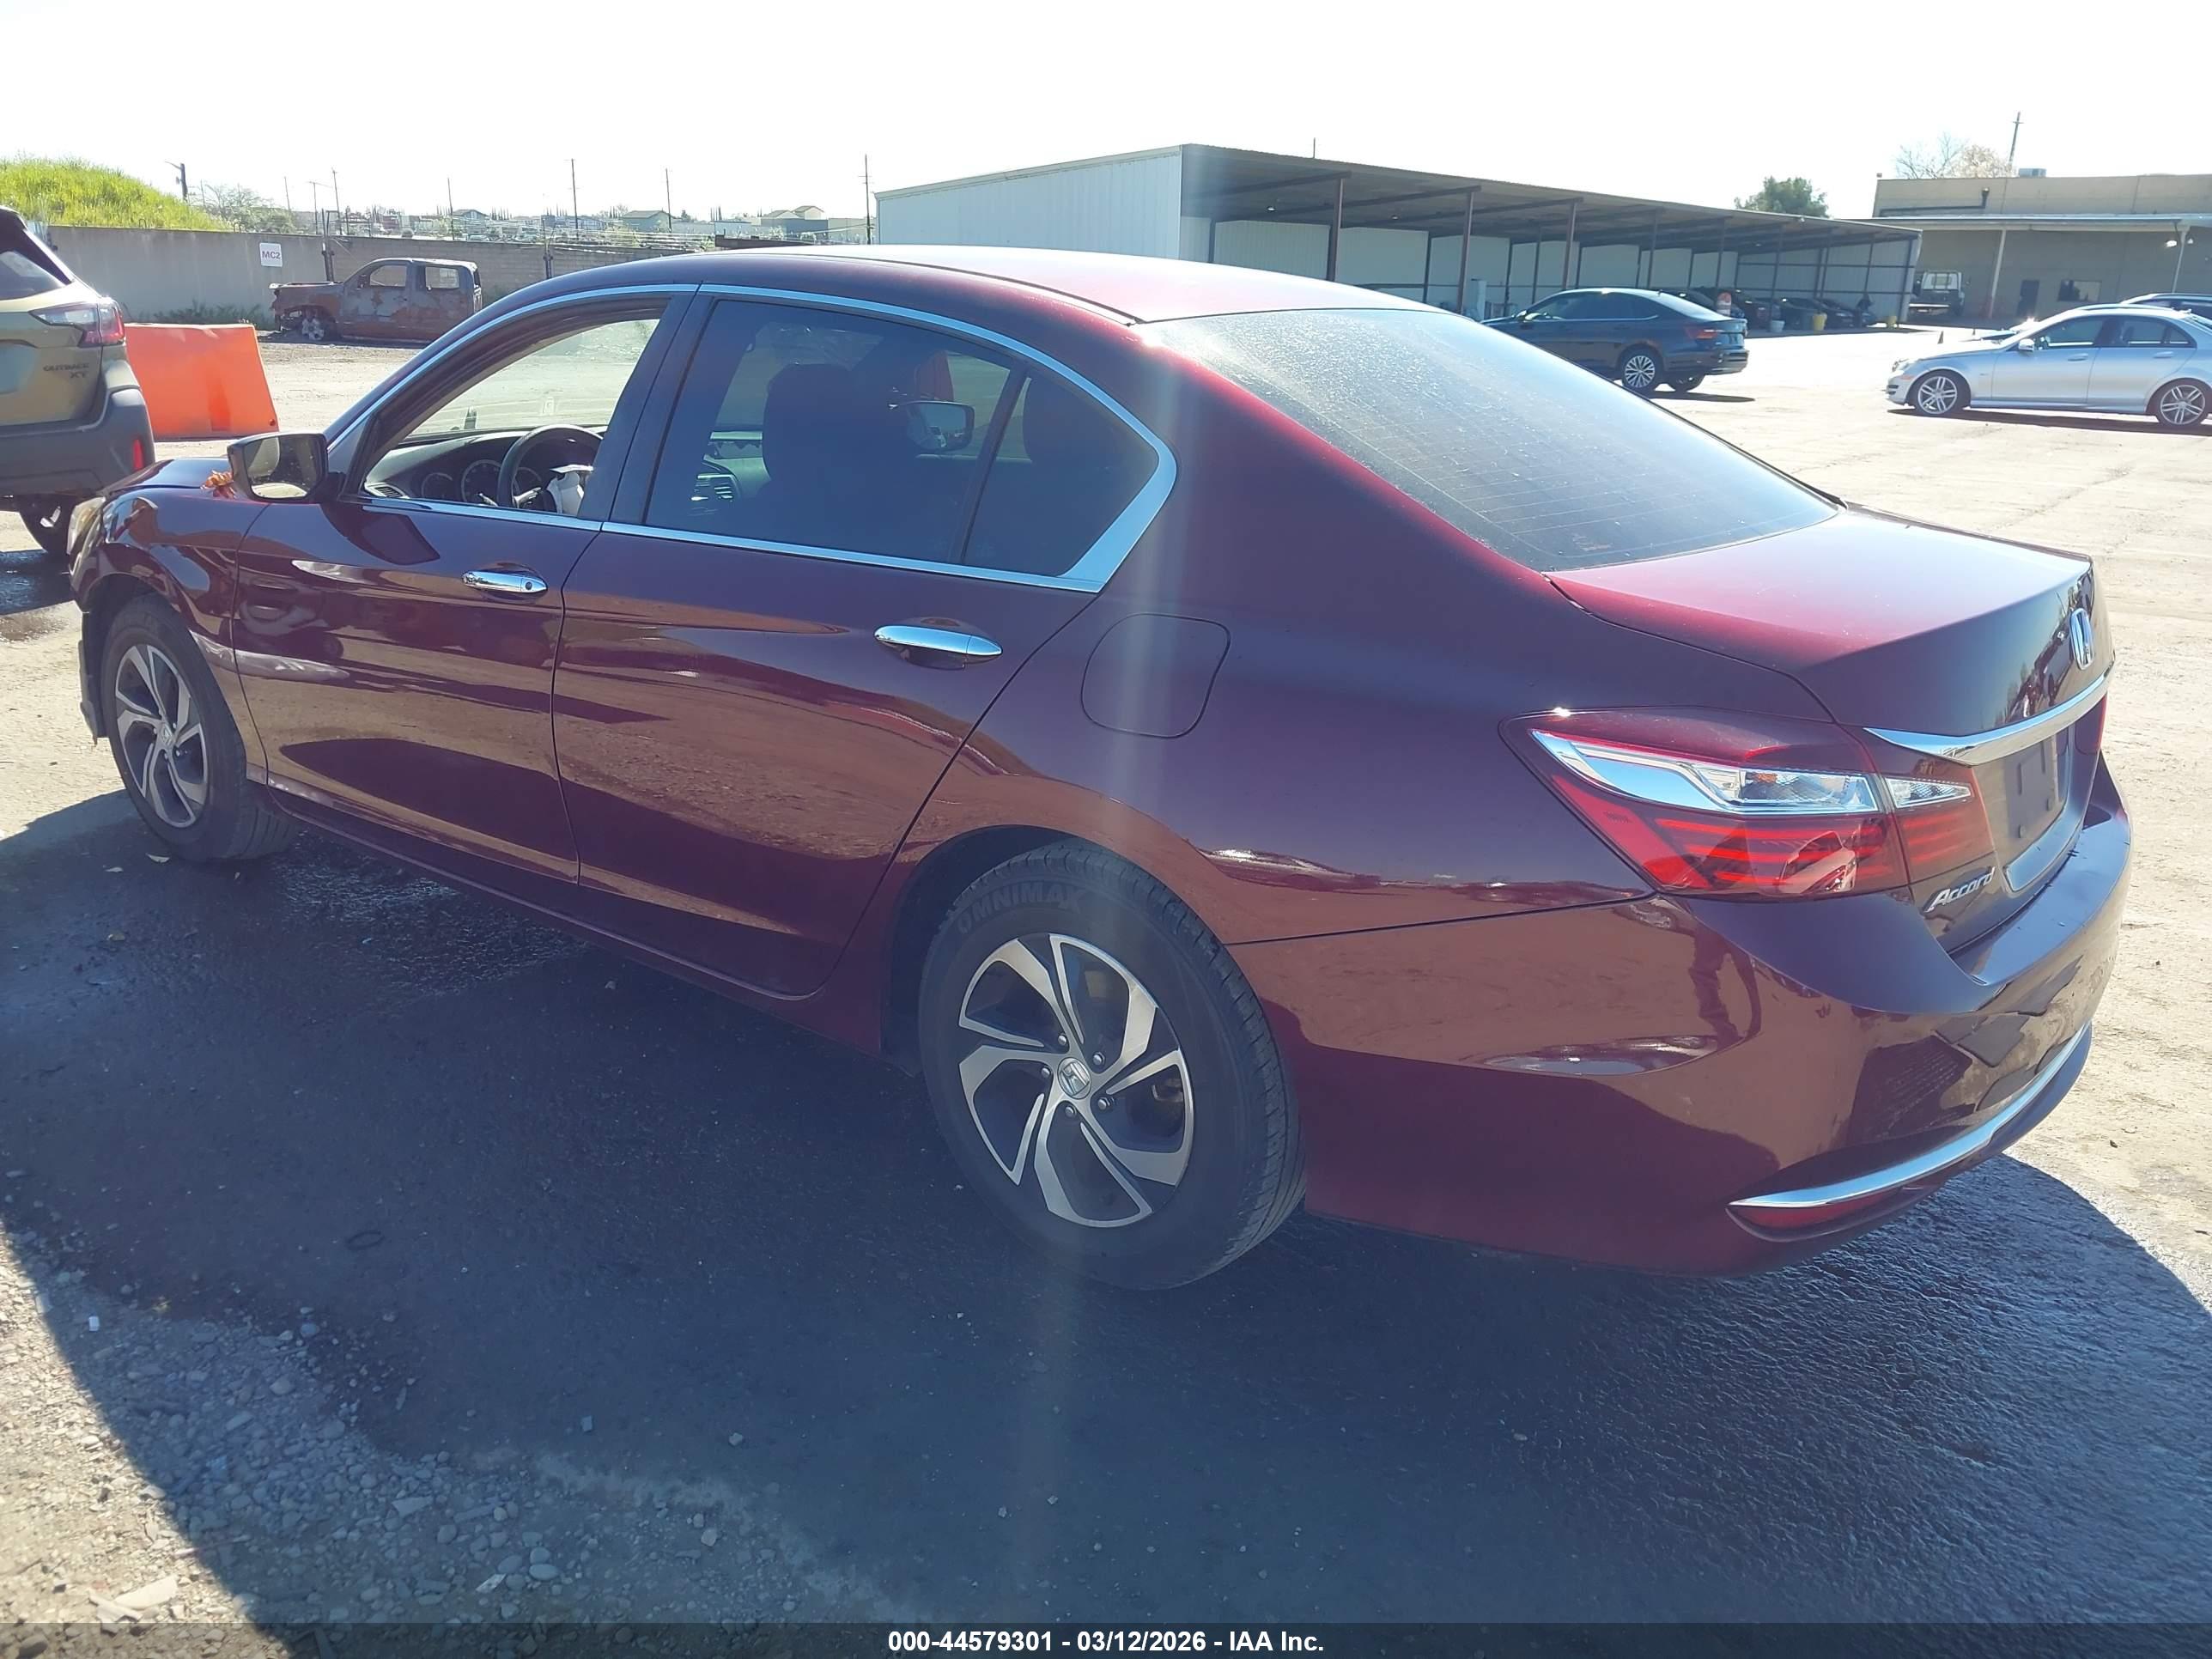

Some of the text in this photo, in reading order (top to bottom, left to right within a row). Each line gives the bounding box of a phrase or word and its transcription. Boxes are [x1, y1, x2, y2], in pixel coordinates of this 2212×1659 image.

[262, 251, 281, 259] MC2
[957, 881, 1085, 934] OMNIMAX
[1923, 866, 1996, 914] Accord
